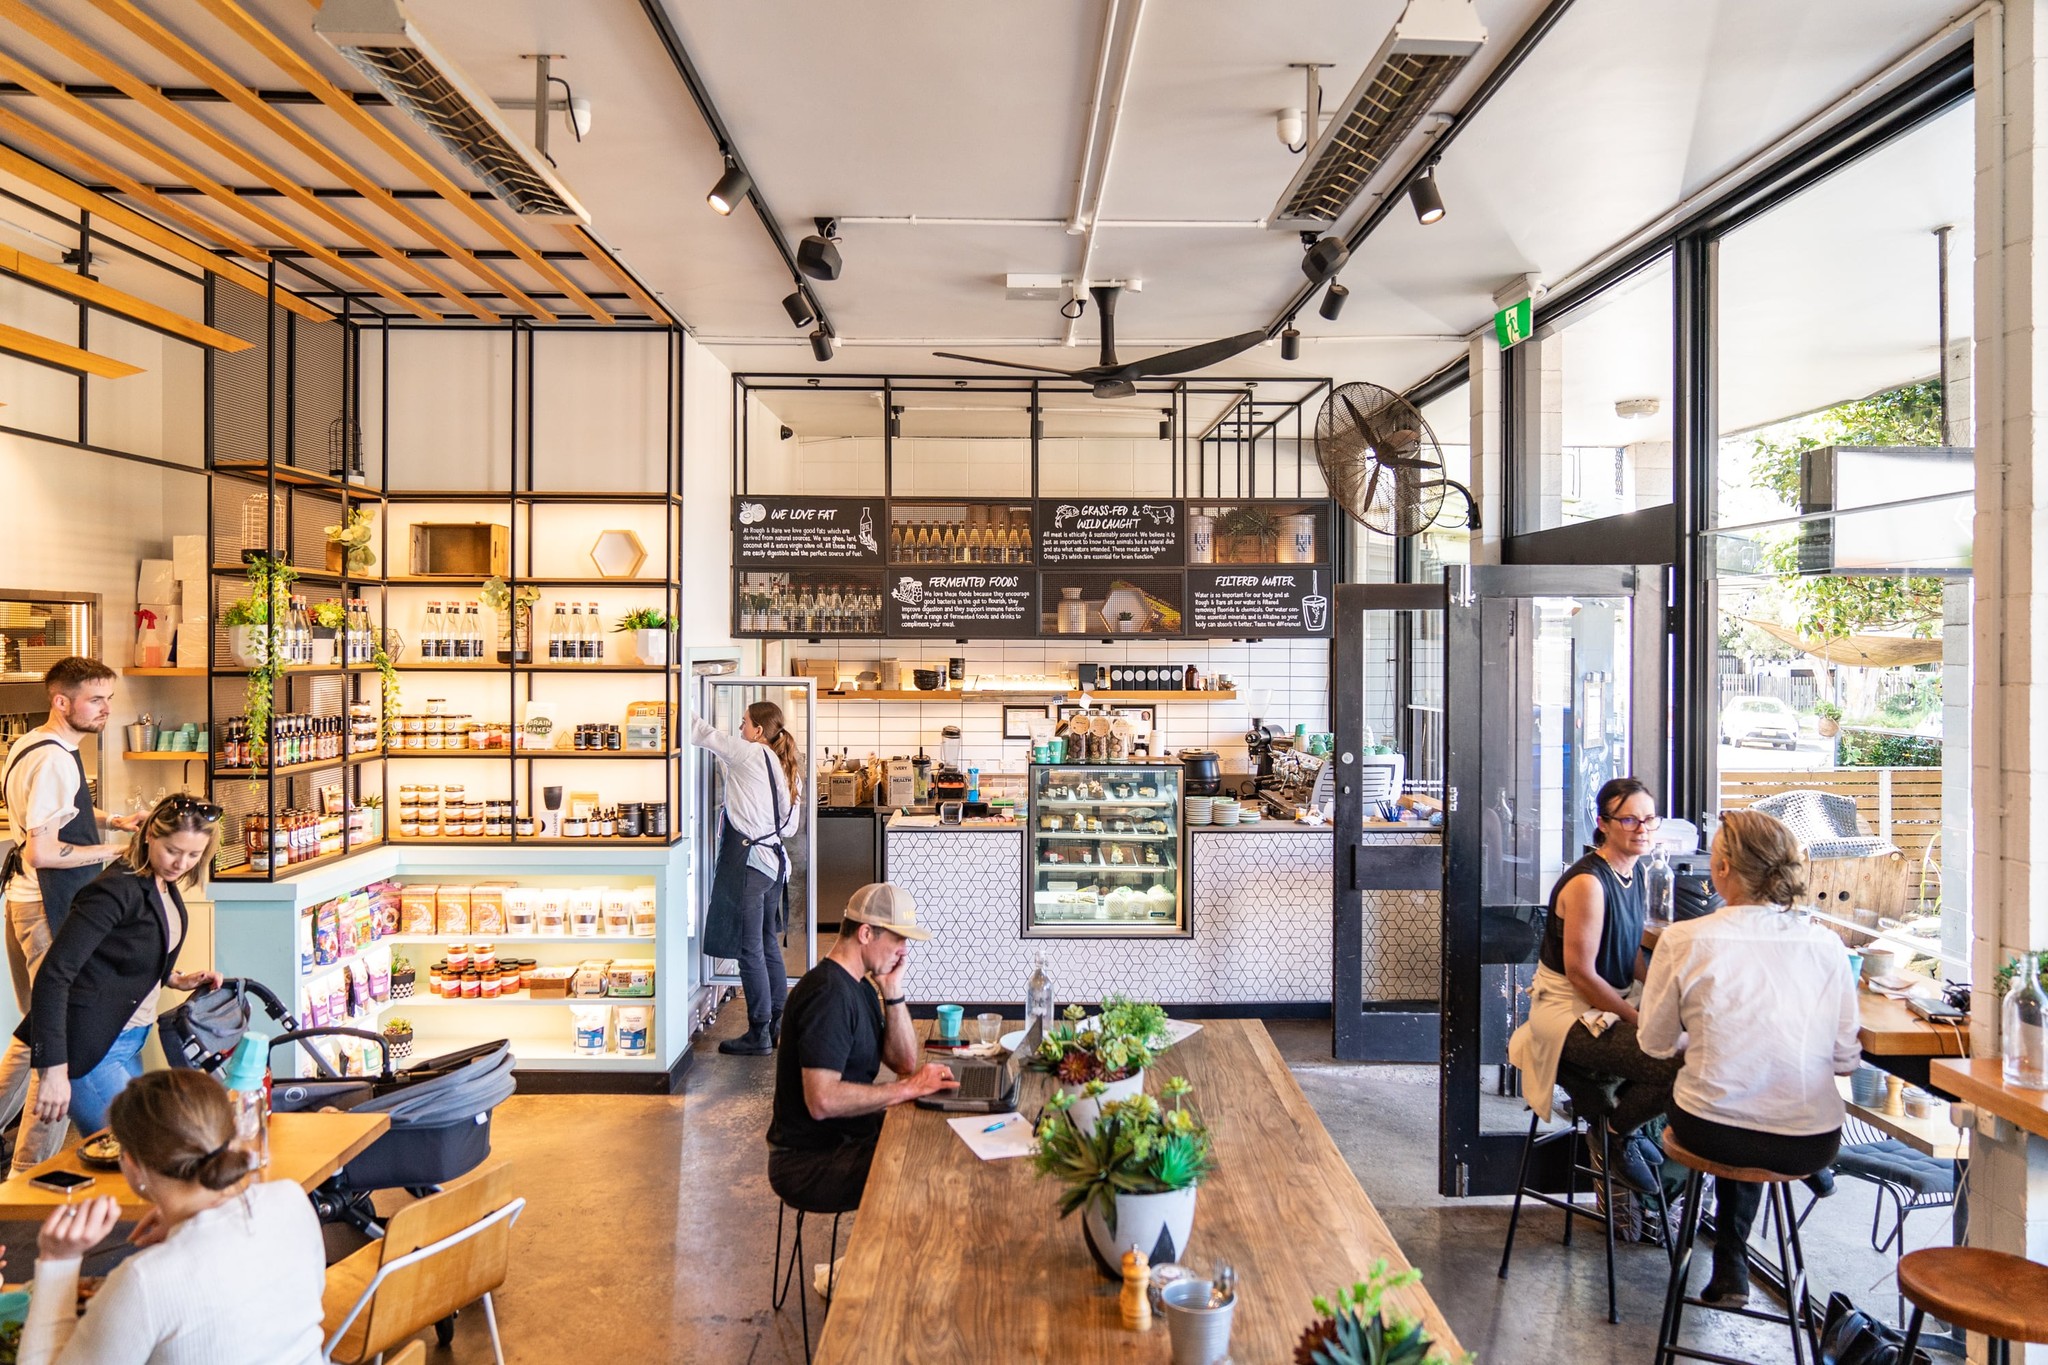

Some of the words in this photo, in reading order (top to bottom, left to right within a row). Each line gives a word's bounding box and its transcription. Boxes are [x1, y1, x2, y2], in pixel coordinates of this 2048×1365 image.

[771, 510, 788, 520] WE
[790, 510, 816, 520] LOVE
[818, 510, 838, 520] FAT
[1081, 505, 1128, 517] GRASS-FED
[1132, 506, 1140, 516] &
[1077, 518, 1101, 529] WILD
[1102, 518, 1141, 529] CAUGHT
[929, 576, 986, 588] FERMENTED
[989, 576, 1018, 588] FOODS
[1215, 576, 1258, 587] FILTERED
[1262, 576, 1296, 587] WATER
